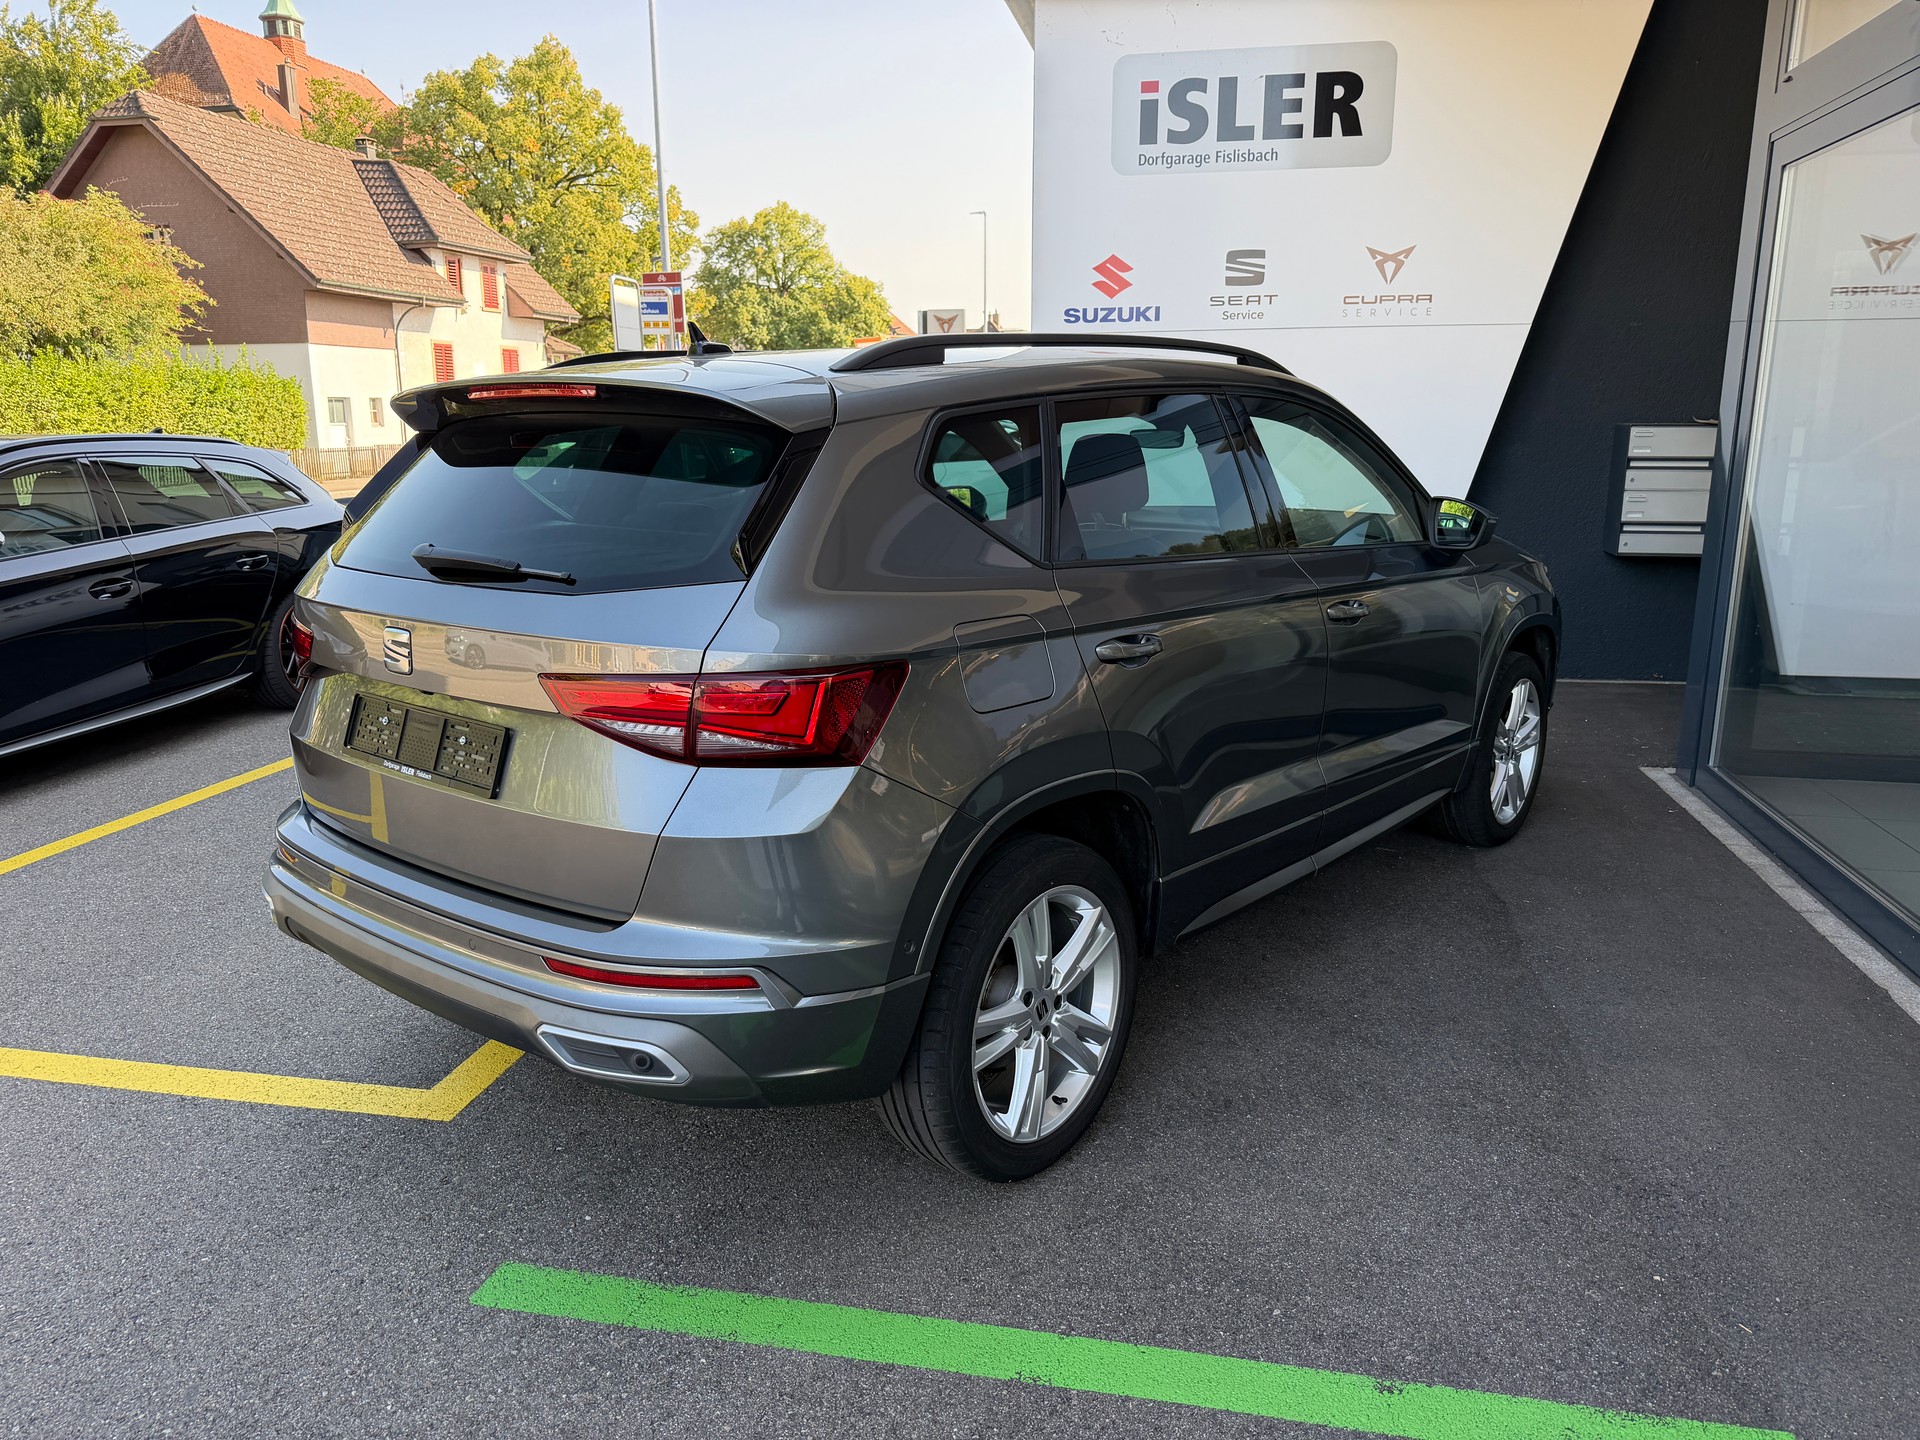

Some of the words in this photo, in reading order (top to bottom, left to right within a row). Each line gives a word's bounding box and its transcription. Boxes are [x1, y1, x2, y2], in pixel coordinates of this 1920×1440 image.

[1138, 152, 1211, 169] Dorfgarage
[1215, 148, 1279, 164] Fislisbach
[1209, 294, 1279, 307] SEAT
[1343, 294, 1433, 305] CUPRA
[1063, 305, 1161, 324] SUZUKI
[1222, 310, 1265, 321] Service
[1342, 307, 1433, 318] SERVICE
